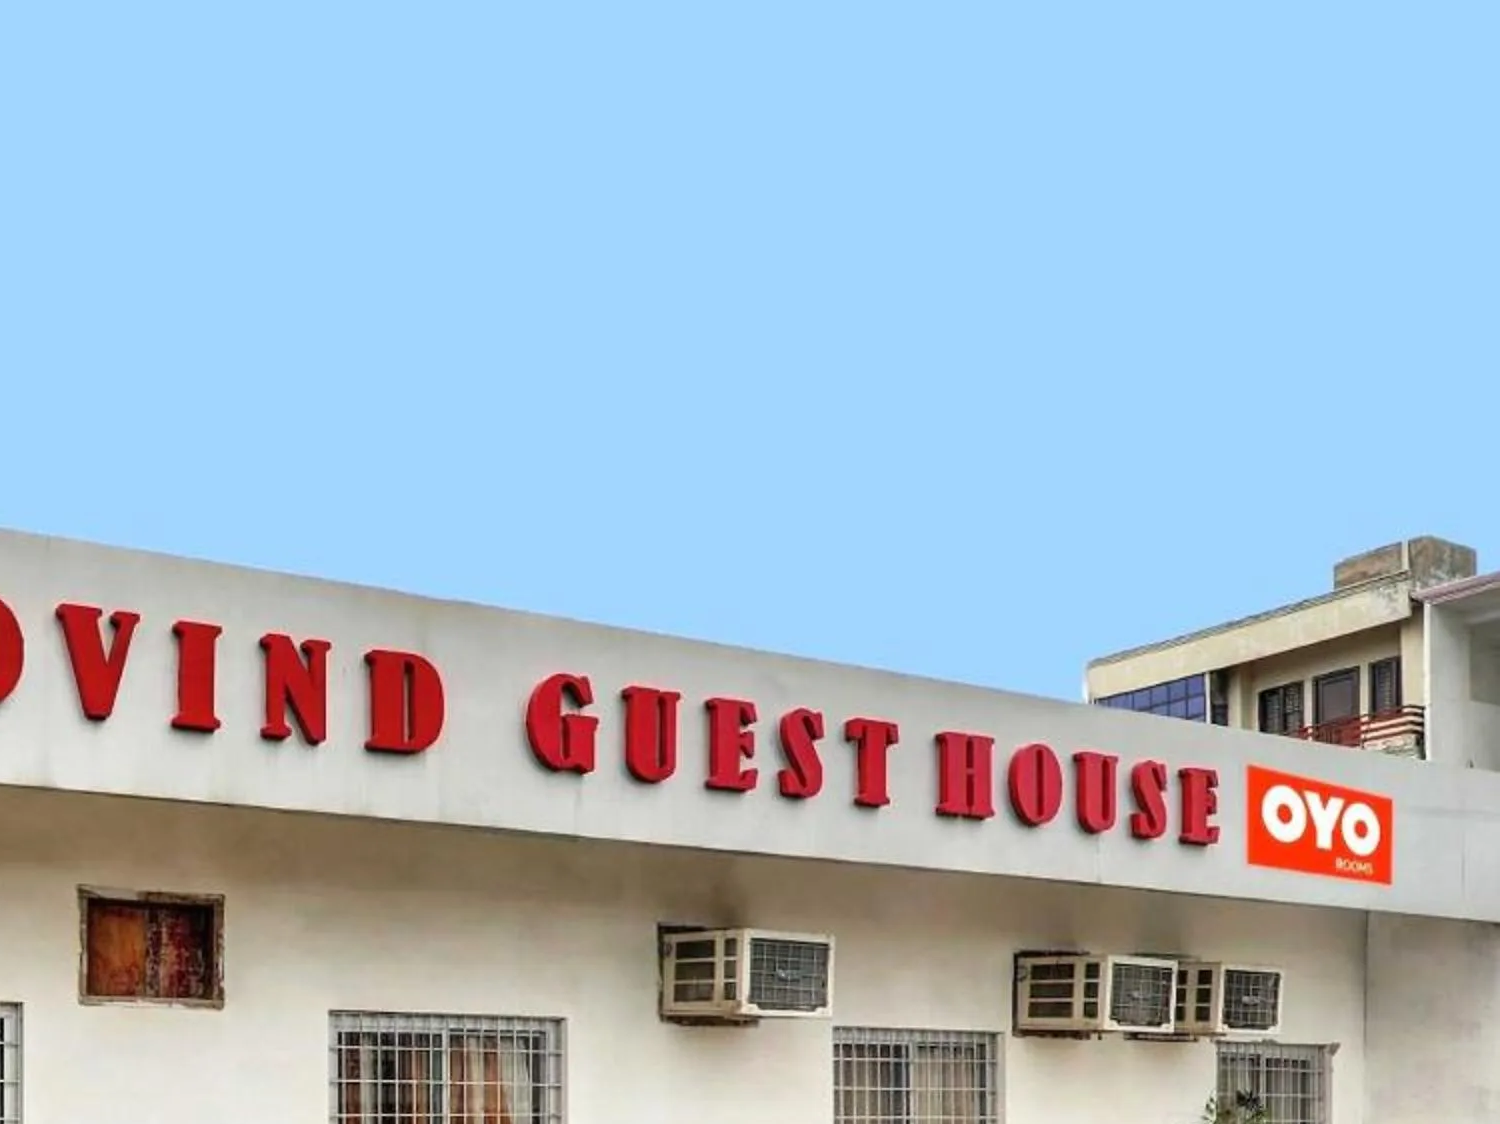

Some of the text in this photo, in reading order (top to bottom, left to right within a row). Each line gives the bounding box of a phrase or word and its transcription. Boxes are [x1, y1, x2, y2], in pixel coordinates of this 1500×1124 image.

[524, 672, 900, 808] GUEST
[935, 730, 1221, 845] HOUSE
[1262, 784, 1381, 857] OYO
[1334, 856, 1374, 876] ROOMS
